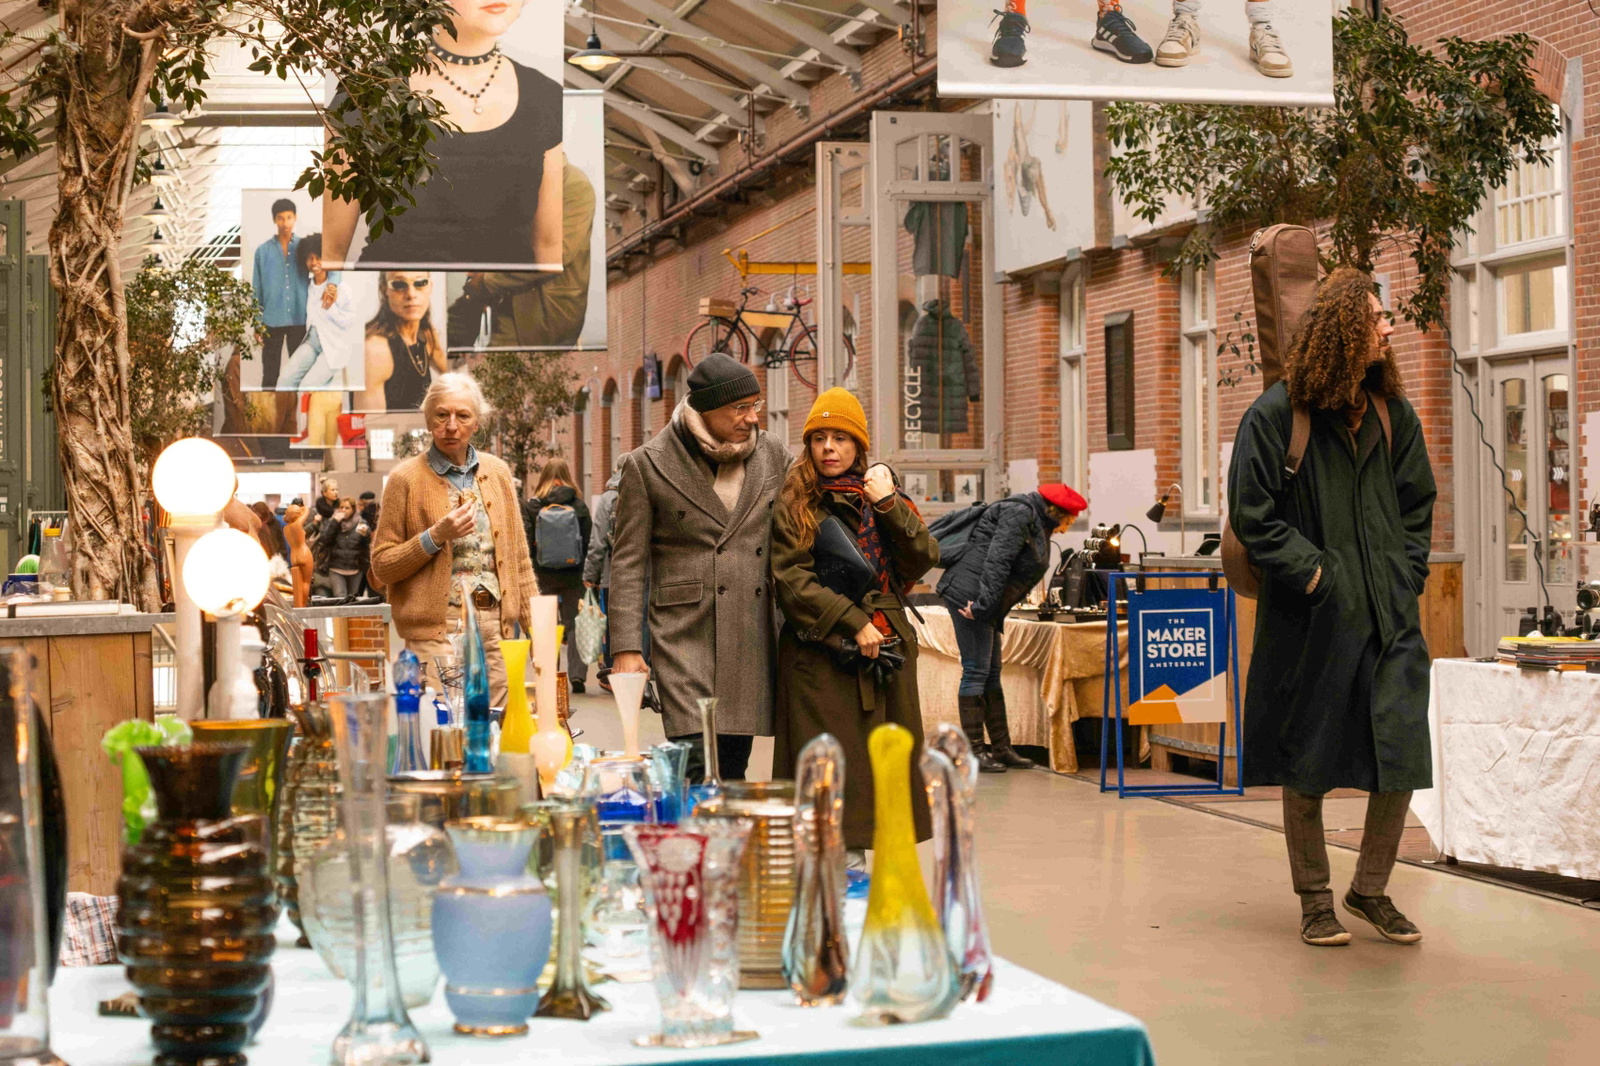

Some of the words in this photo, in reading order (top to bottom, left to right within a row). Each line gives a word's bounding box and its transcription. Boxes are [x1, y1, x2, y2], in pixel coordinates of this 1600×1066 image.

[904, 365, 922, 443] RECYCLE
[1147, 626, 1207, 643] MAKER
[1147, 642, 1207, 659] STORE
